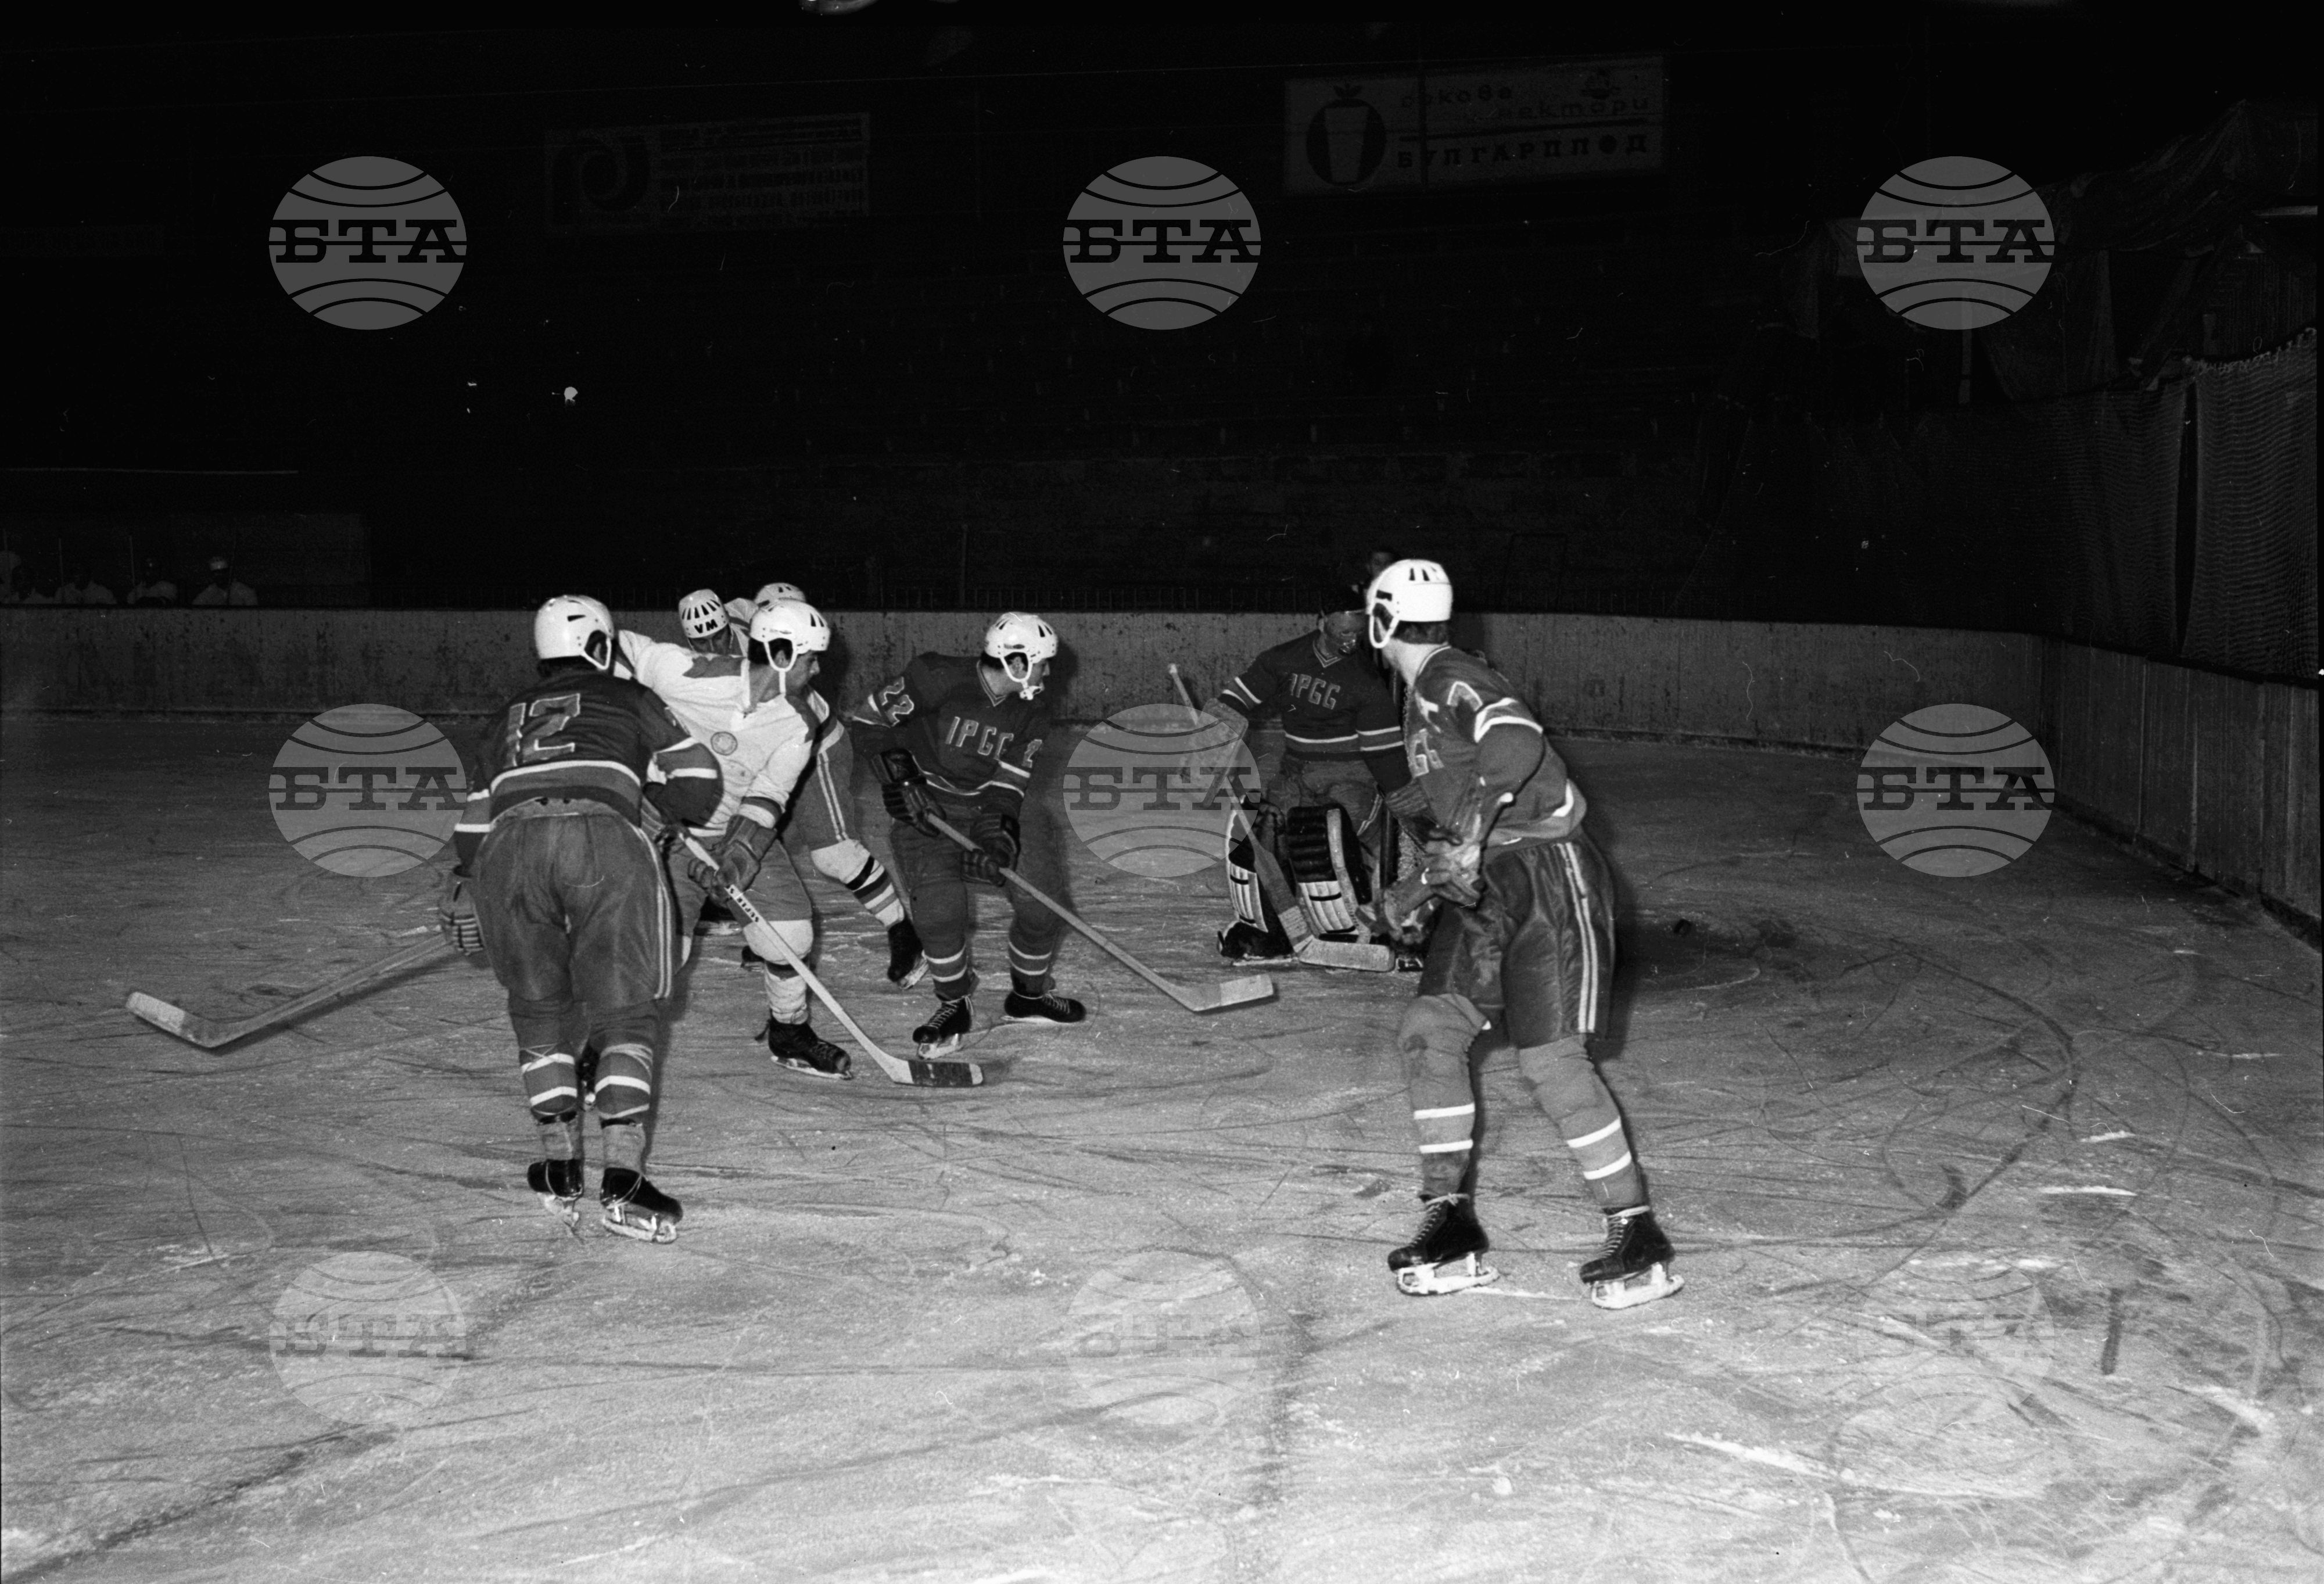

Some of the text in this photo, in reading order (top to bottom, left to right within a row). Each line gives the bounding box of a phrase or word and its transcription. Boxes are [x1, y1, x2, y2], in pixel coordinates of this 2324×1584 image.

[694, 619, 718, 634] VM
[877, 676, 914, 728] 22
[504, 693, 581, 769] 12
